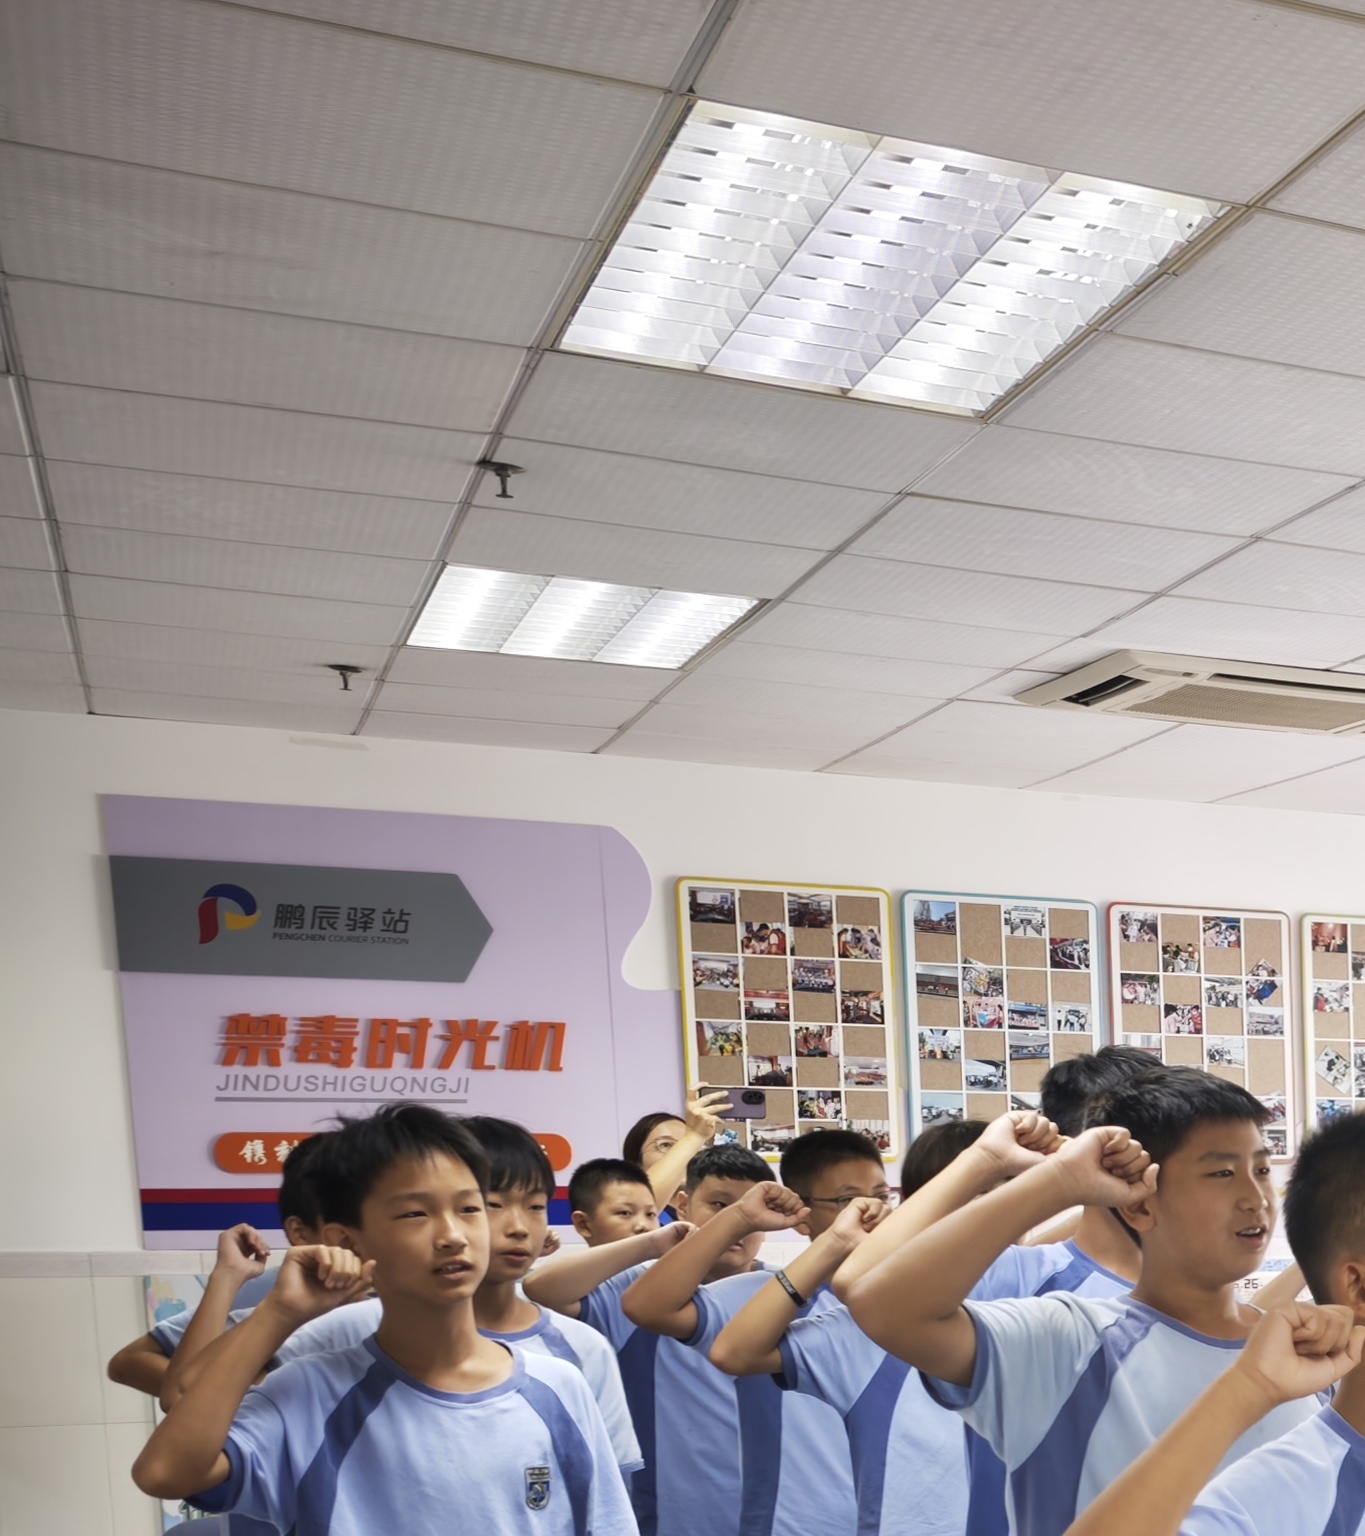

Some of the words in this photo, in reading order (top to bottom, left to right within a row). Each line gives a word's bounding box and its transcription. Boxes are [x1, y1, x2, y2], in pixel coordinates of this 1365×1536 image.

[273, 903, 412, 934] 鹏辰驿站
[272, 931, 326, 942] PENGCHEN
[328, 934, 368, 944] COURIER
[370, 936, 410, 945] STATION
[219, 1013, 567, 1072] 禁毒时光机
